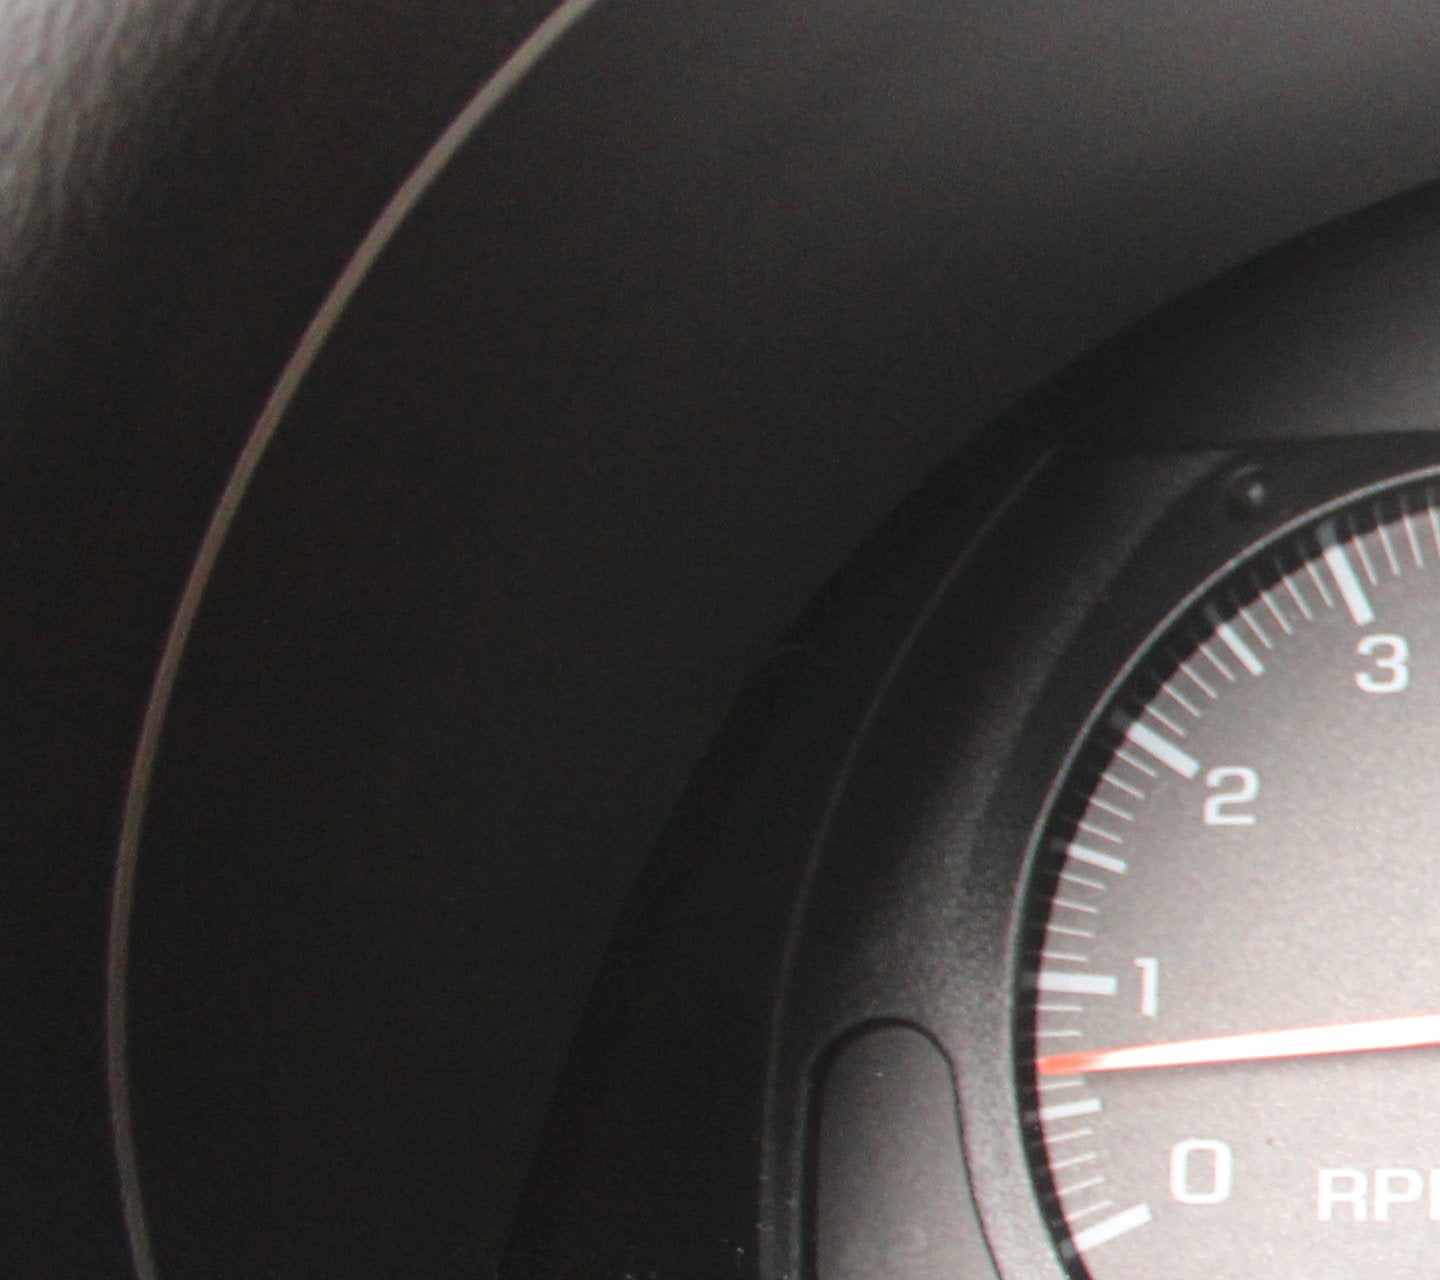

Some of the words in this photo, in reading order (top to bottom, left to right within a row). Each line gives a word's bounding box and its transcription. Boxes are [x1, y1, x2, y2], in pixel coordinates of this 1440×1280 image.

[1355, 633, 1411, 695] 3
[1203, 765, 1261, 827] 2
[1134, 956, 1160, 1019] 1
[1169, 1137, 1234, 1205] 0
